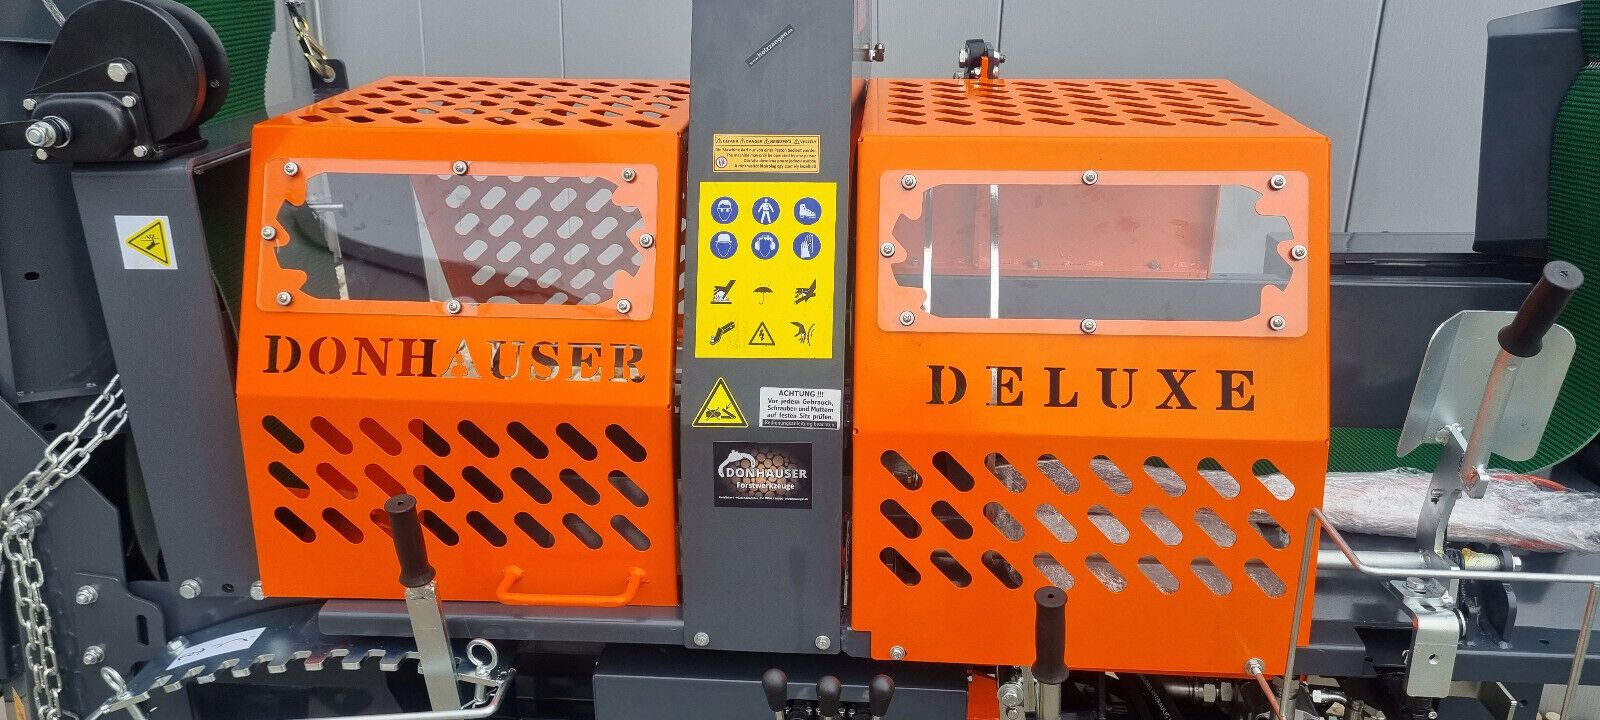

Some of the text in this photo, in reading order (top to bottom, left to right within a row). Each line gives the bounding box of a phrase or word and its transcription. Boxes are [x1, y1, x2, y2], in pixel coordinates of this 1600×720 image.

[262, 335, 647, 383] DONHAUSER
[926, 365, 1255, 411] DELUXE
[726, 467, 808, 479] DONHAUSER
[736, 481, 795, 491] Forstwerkzeuge
